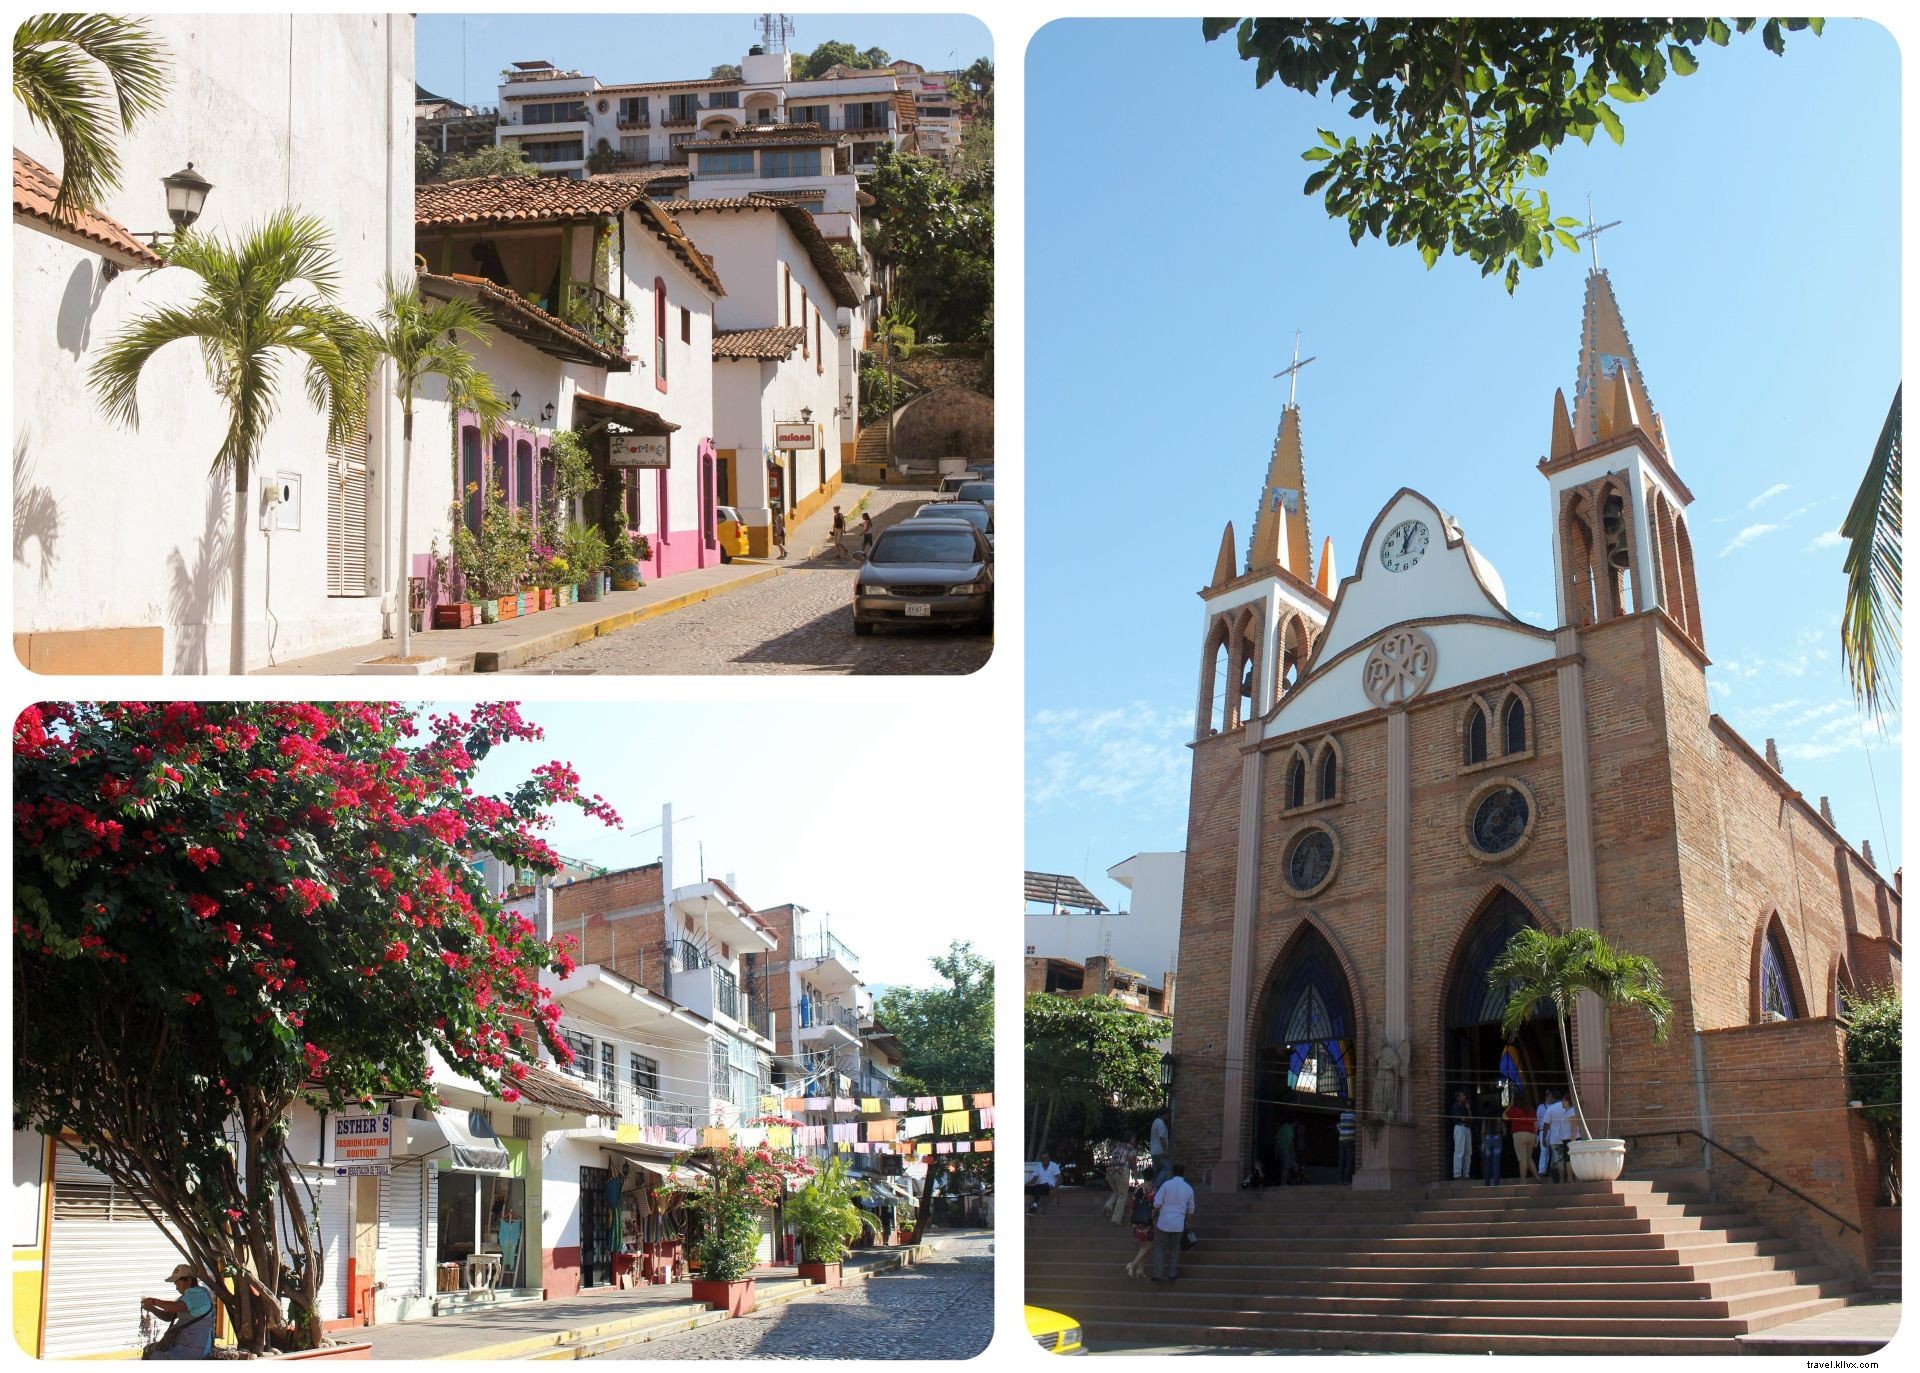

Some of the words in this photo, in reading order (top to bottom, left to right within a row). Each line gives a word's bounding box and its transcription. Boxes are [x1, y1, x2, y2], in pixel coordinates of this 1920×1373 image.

[779, 433, 811, 442] milano
[336, 1139, 362, 1148] FASHION
[363, 1138, 389, 1147] LEATHER
[346, 1149, 378, 1158] BOUTIQUE
[375, 1165, 391, 1175] TEQUILA
